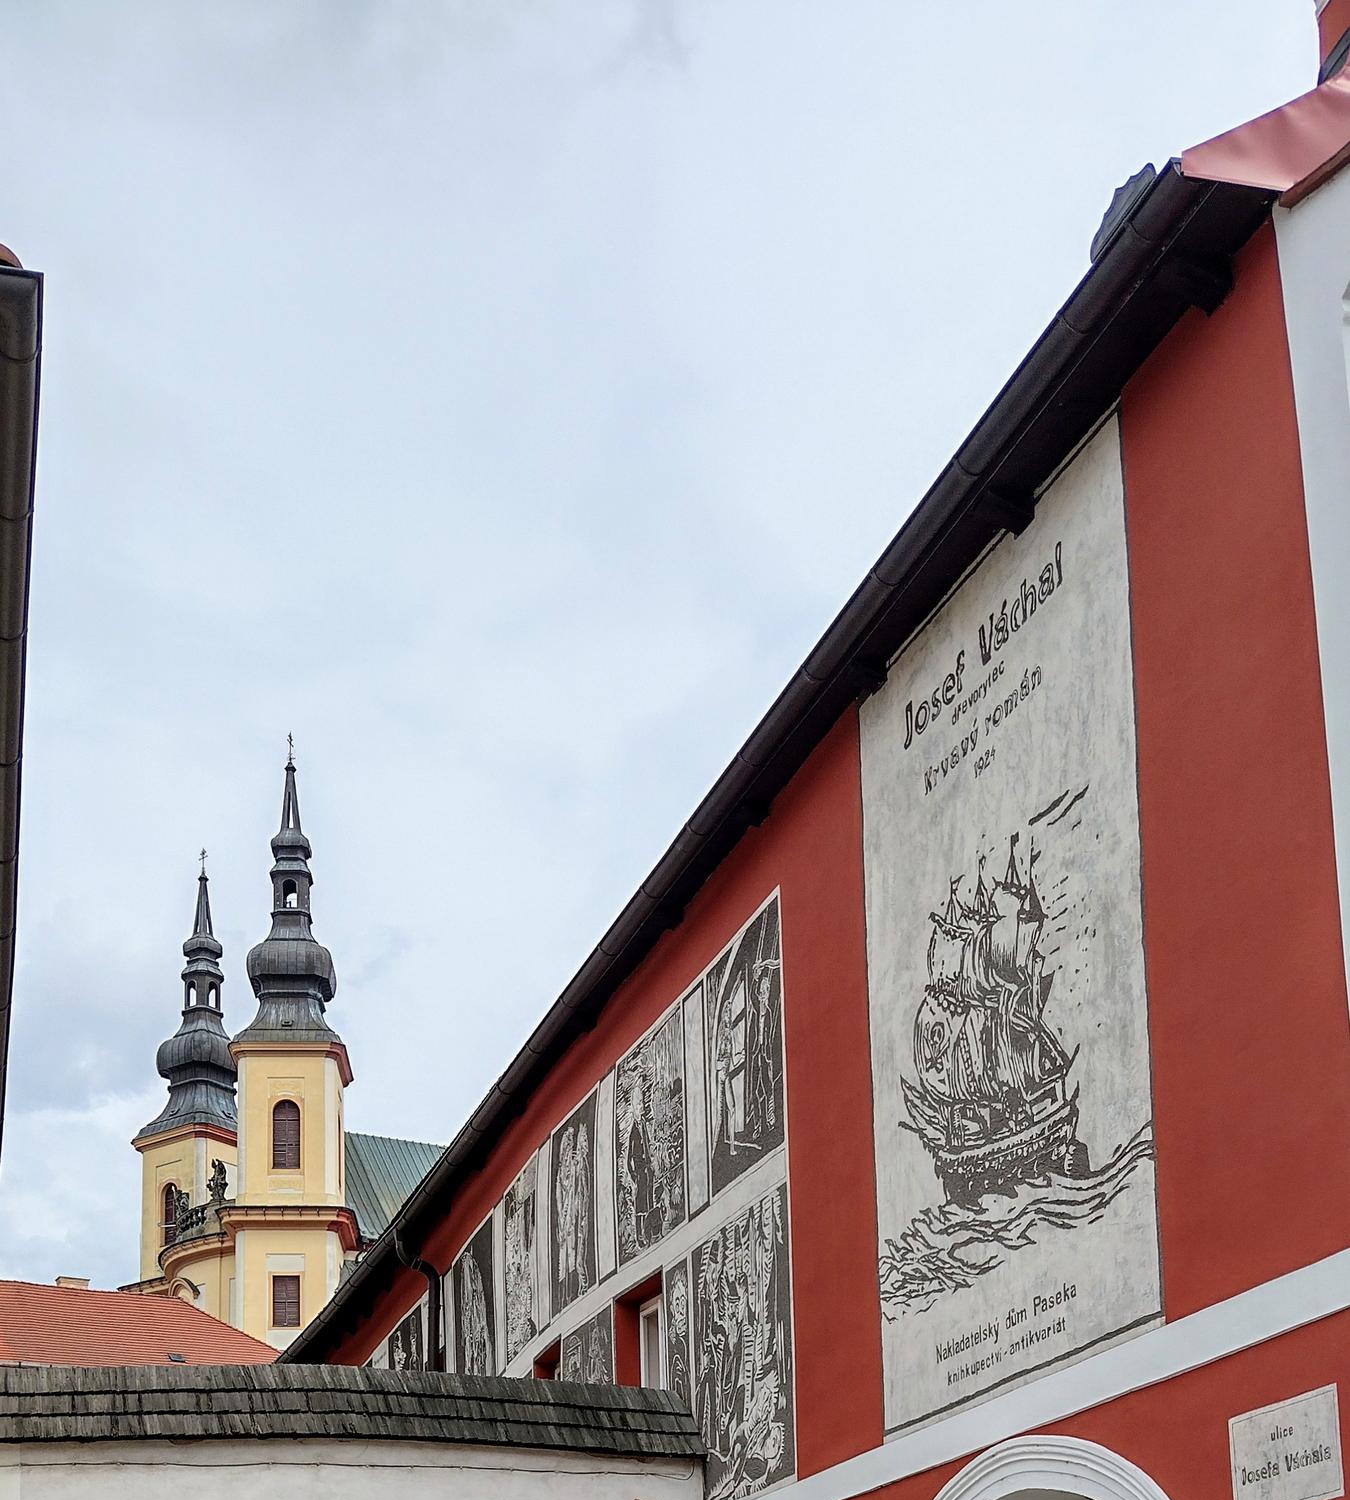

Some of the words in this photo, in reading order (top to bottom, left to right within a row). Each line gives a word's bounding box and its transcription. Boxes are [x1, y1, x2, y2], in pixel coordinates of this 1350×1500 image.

[904, 650, 965, 750] Josef
[978, 541, 1063, 666] Váchal
[924, 718, 978, 796] Krvavý
[985, 665, 1042, 736] román
[973, 745, 996, 779] 1924
[935, 1317, 1000, 1364] Nakladatelský
[1005, 1307, 1028, 1330] dům
[1032, 1282, 1077, 1317] Paseka
[1241, 1461, 1280, 1486] Josefa
[1284, 1443, 1332, 1472] Váchala
[1270, 1425, 1294, 1442] ulice
